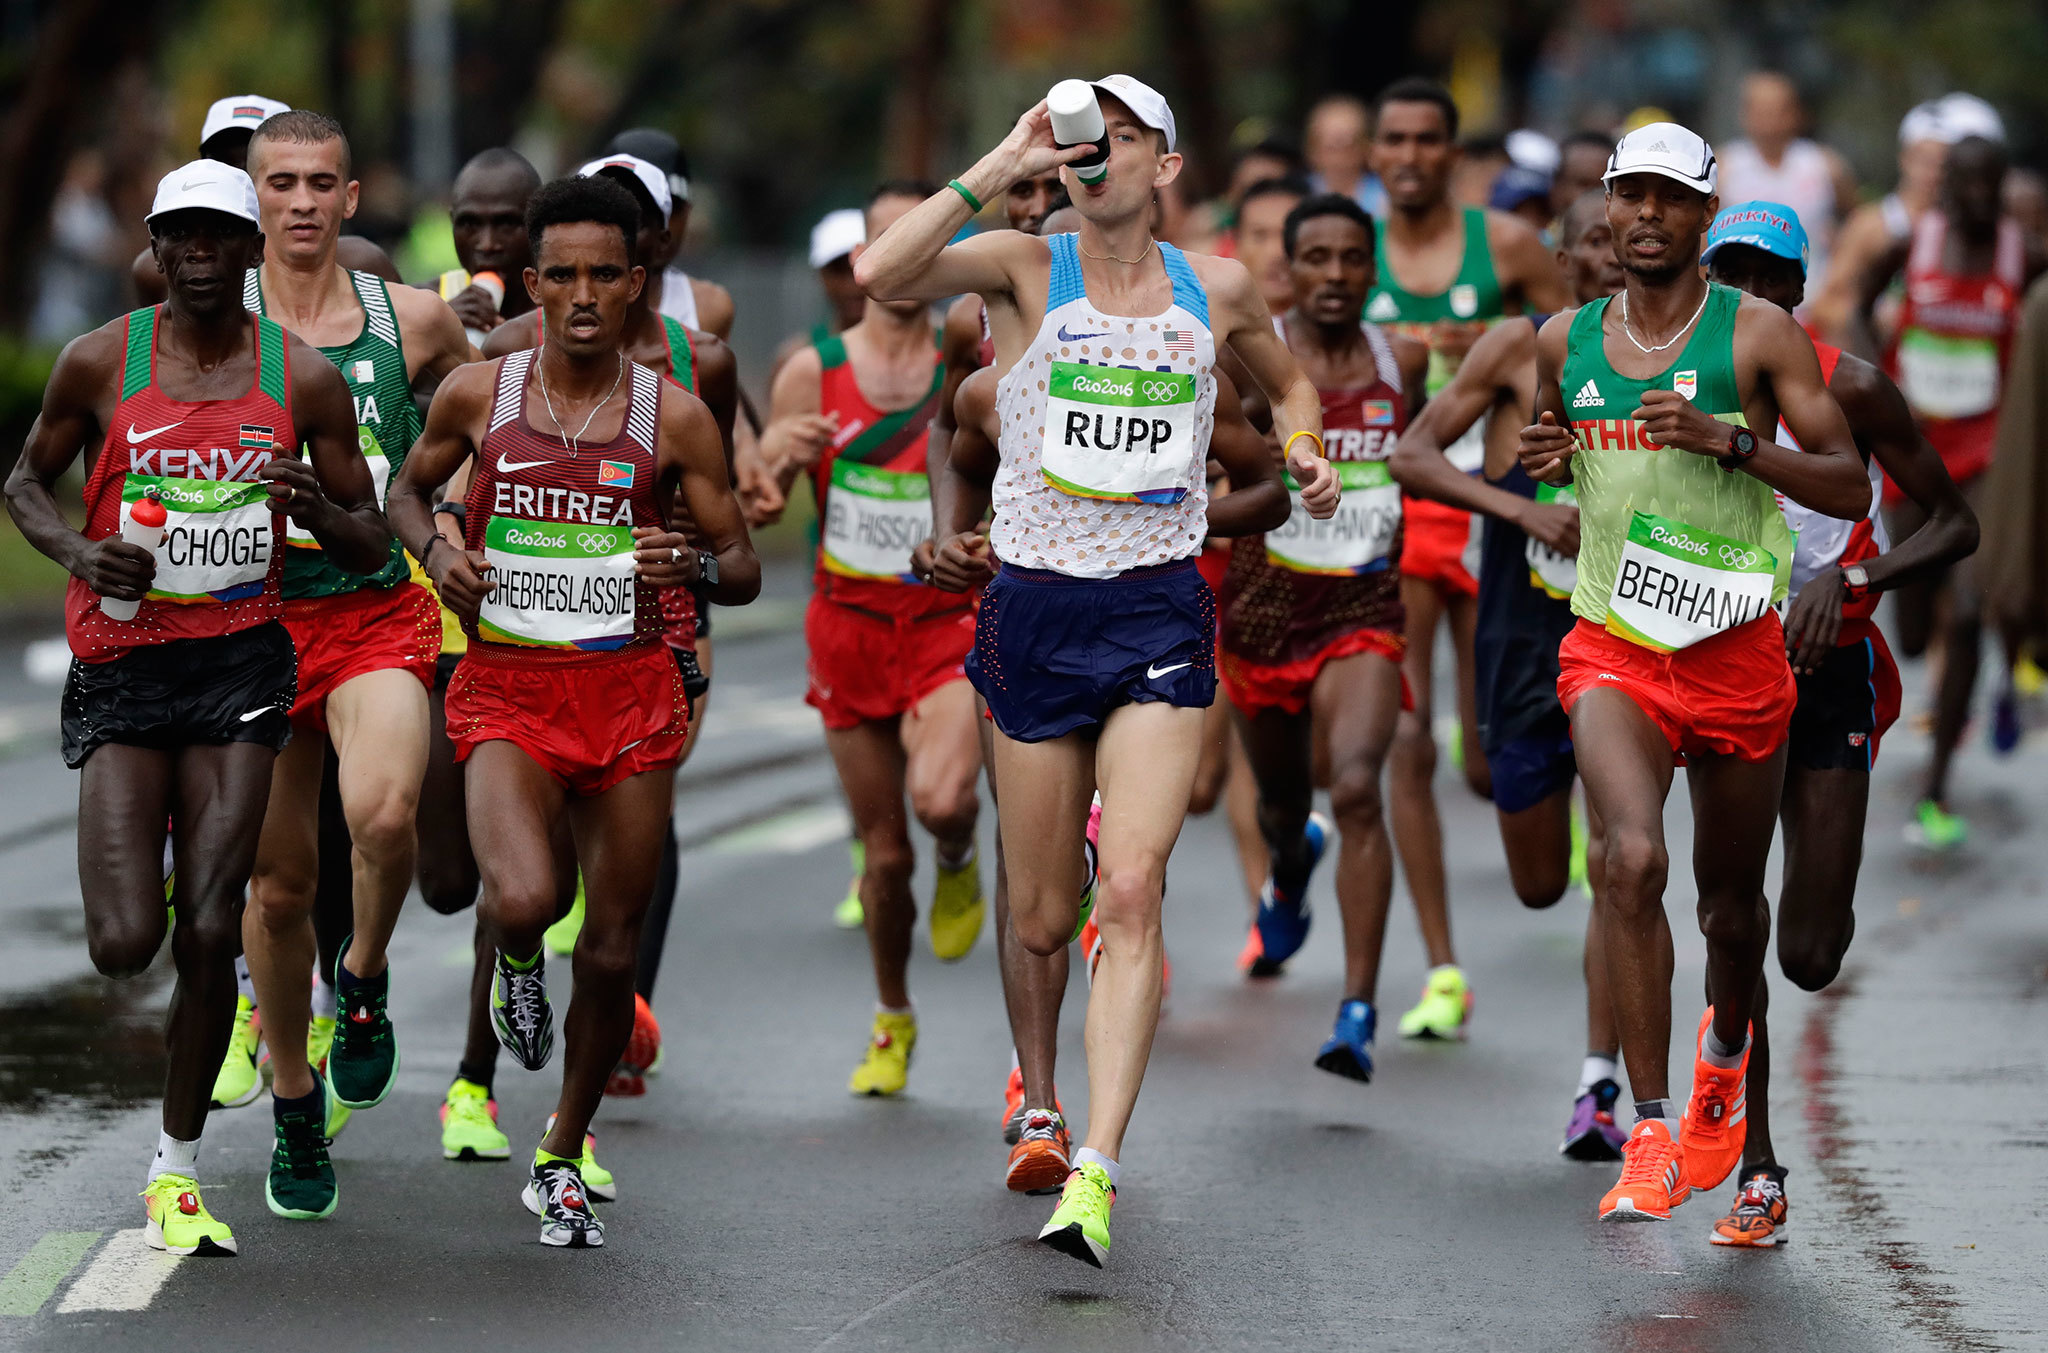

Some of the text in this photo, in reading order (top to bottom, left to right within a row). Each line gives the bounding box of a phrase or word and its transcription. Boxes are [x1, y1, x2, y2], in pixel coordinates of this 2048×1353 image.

[1072, 375, 1134, 397] Rio2016
[1572, 396, 1605, 408] adidas
[1064, 410, 1172, 454] RUPP
[1323, 428, 1398, 461] TREA
[129, 448, 274, 482] KENYA
[494, 481, 634, 527] ERITREA
[157, 526, 268, 567] CHOGE
[505, 529, 567, 549] Rio2016
[1650, 526, 1710, 557] Rio2016
[486, 565, 633, 616] GHEBRESLASSIE
